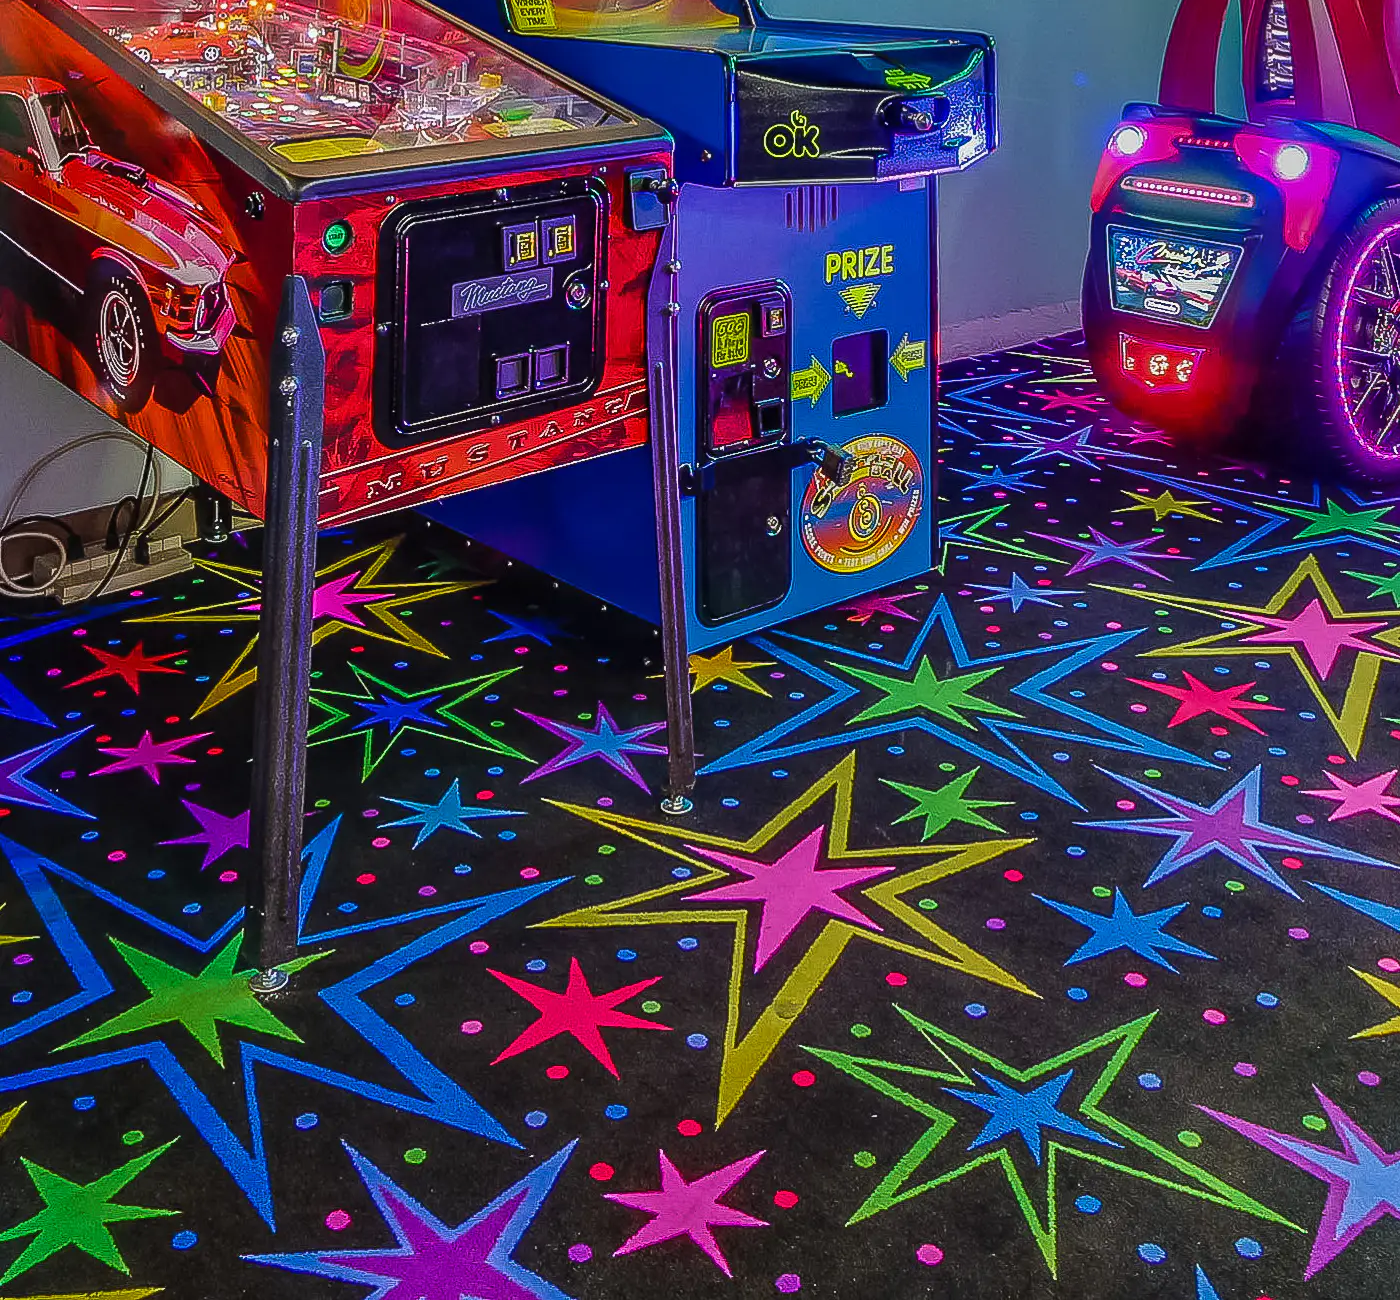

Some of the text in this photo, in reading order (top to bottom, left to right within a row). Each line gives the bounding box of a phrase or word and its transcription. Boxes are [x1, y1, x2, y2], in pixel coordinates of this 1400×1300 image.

[520, 7, 547, 17] EVERY
[764, 122, 820, 158] OK
[825, 245, 895, 284] PRIZE
[460, 276, 548, 312] Mustang
